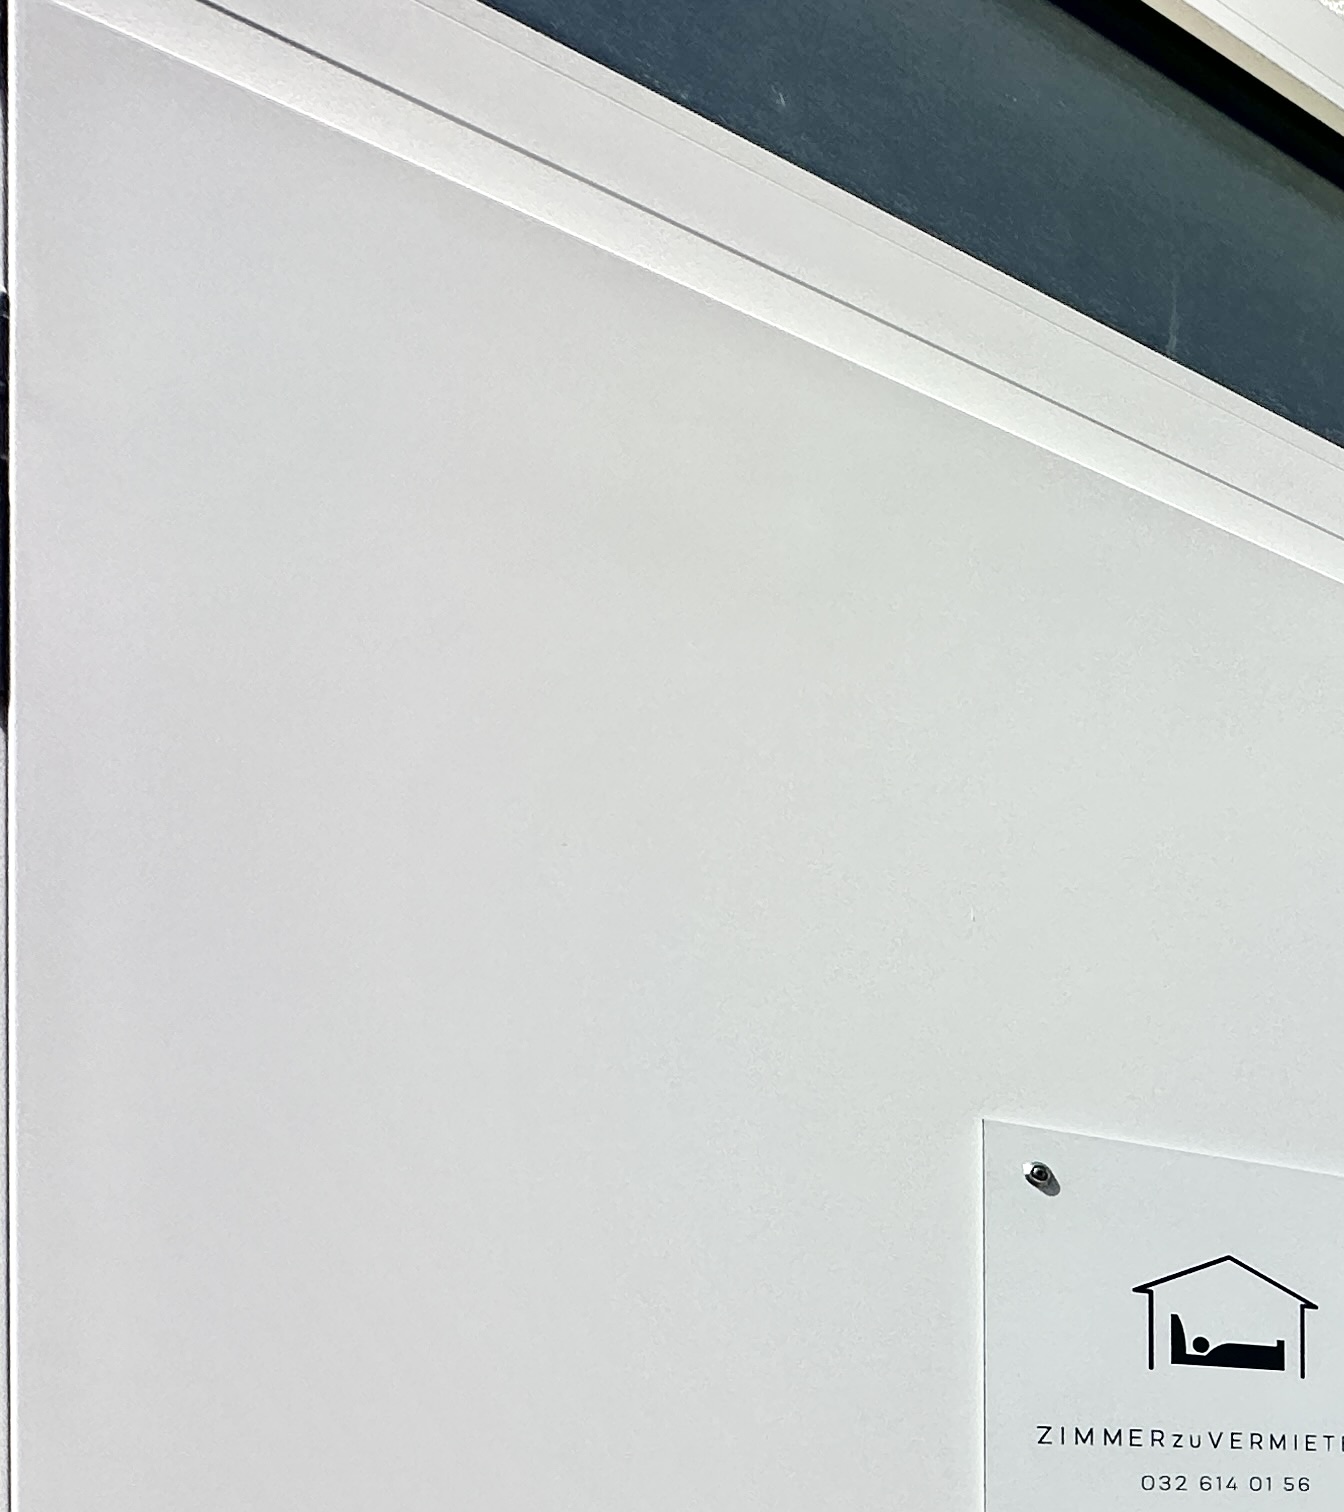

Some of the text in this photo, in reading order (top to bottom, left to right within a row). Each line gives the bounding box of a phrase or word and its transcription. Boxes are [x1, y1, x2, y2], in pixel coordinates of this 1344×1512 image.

[1141, 1474, 1311, 1493] 032 614 01 56
